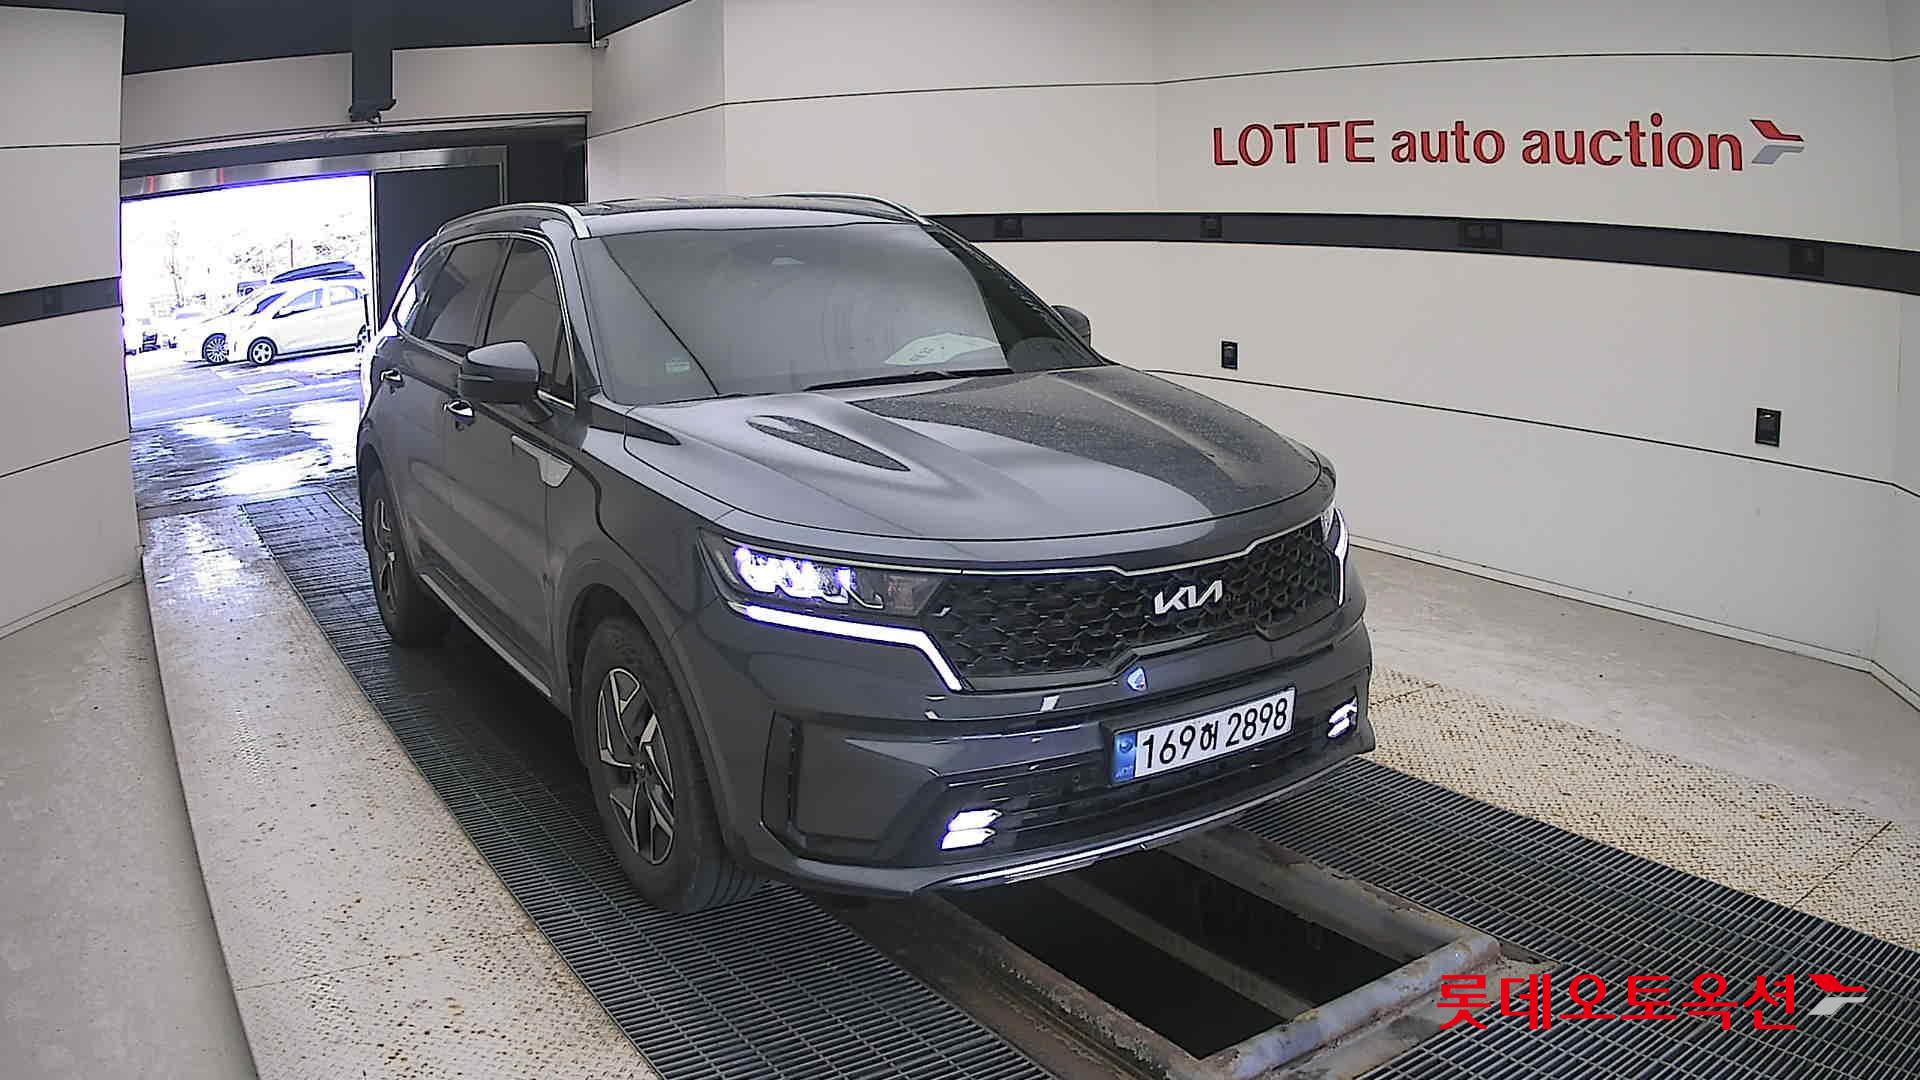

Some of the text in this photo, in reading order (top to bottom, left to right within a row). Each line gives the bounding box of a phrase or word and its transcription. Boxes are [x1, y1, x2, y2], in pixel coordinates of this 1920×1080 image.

[1213, 112, 1744, 171] LOTTE auto auction
[1154, 579, 1223, 615] KIA
[1225, 697, 1288, 748] 2898
